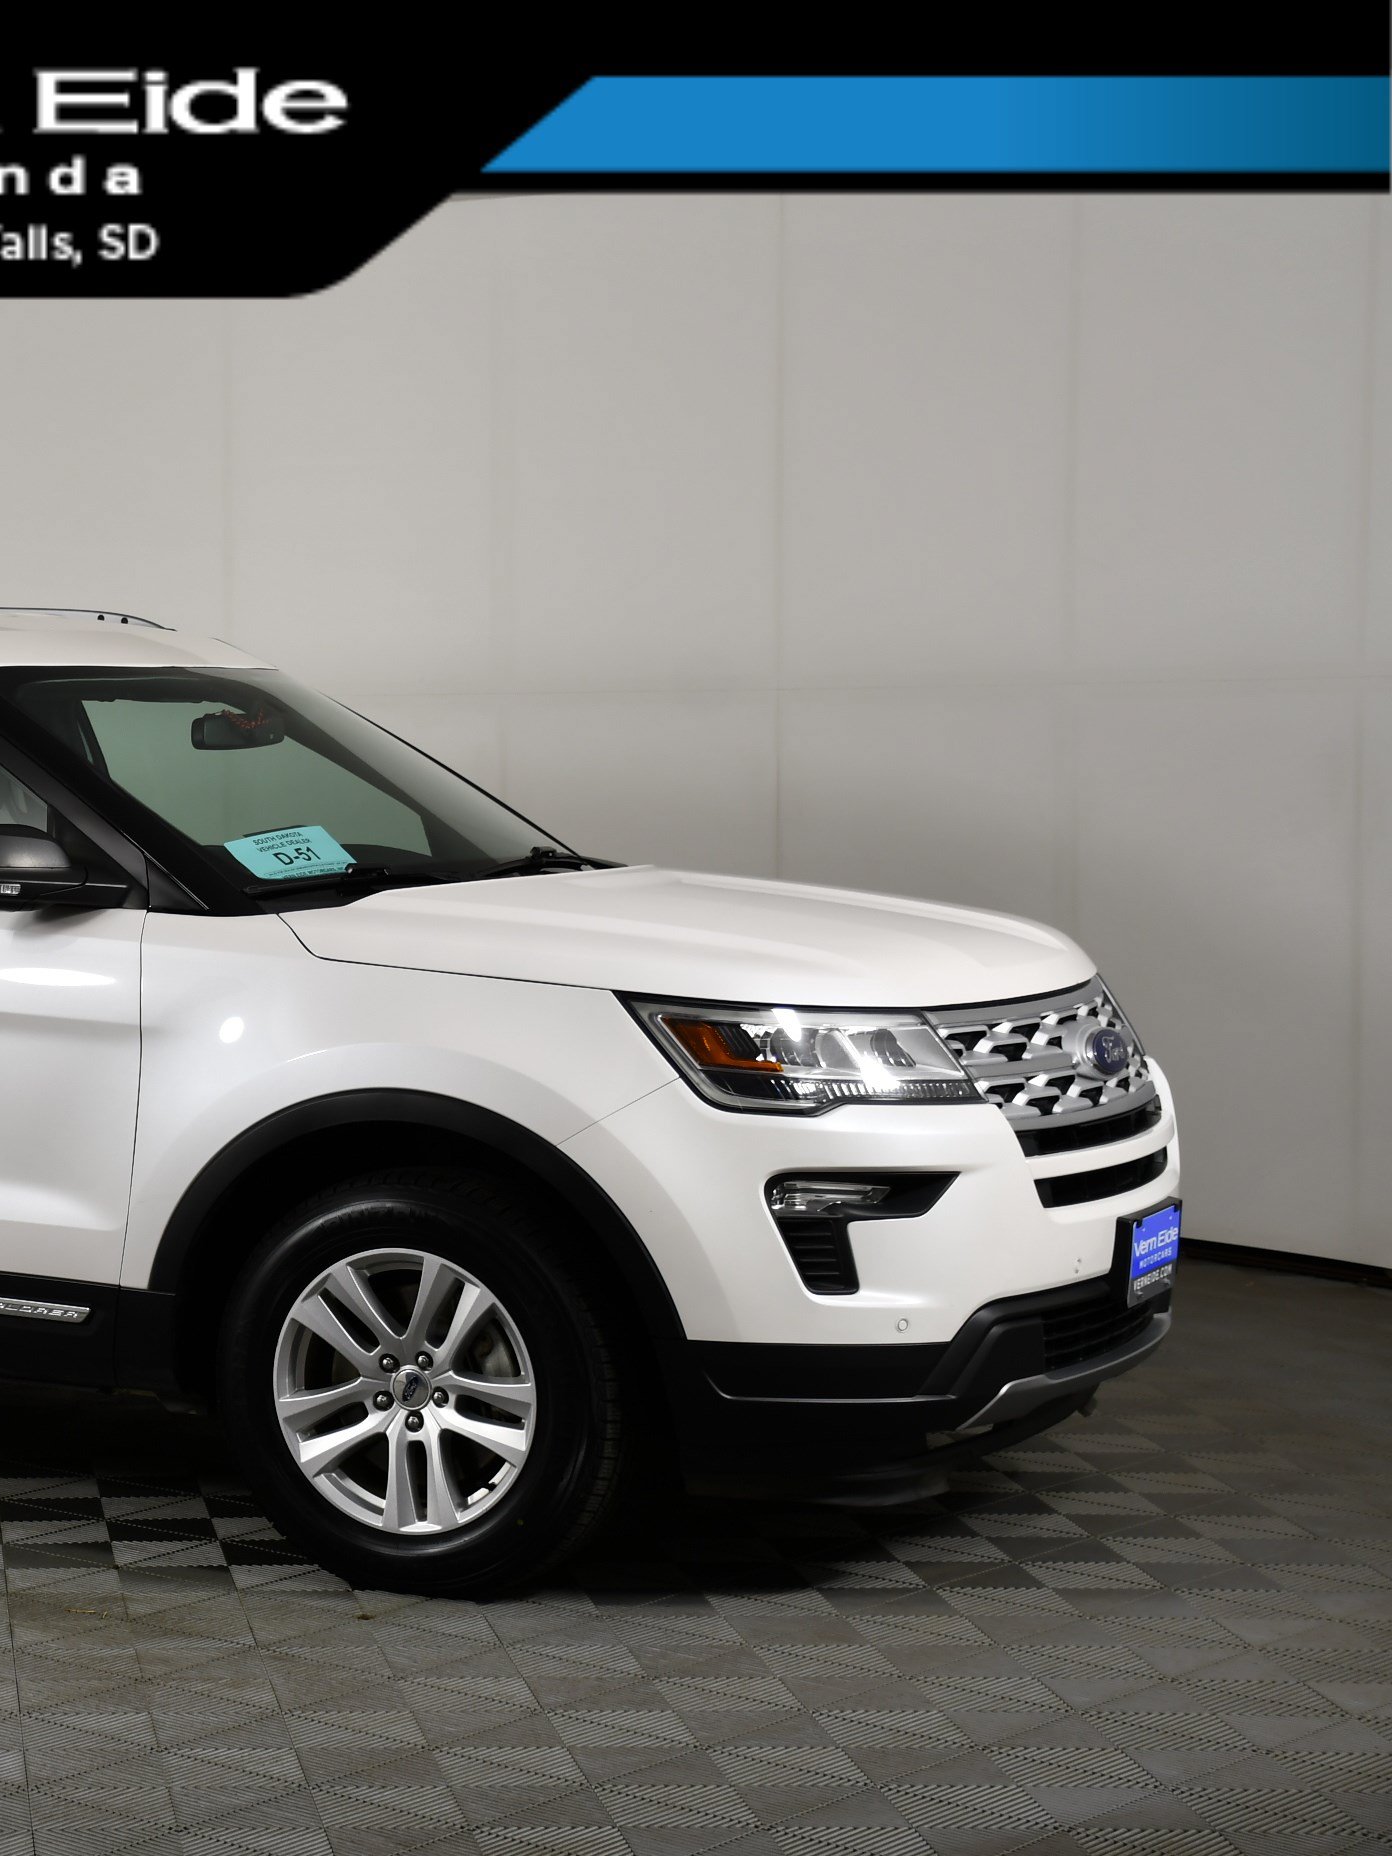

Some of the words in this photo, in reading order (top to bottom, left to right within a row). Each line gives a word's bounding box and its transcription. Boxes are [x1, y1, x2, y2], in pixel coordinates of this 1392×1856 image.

[252, 834, 277, 846] SOUTH
[275, 831, 304, 841] DAKOTA
[257, 841, 288, 853] VEHICLE
[285, 837, 312, 847] DEALER
[272, 846, 322, 866] D-51
[1102, 1036, 1127, 1063] Ford
[1134, 1236, 1158, 1257] Vern
[1157, 1226, 1179, 1247] Eide
[1139, 1247, 1173, 1270] MOTORCARS
[1133, 1263, 1173, 1292] VERNEIDE.COM
